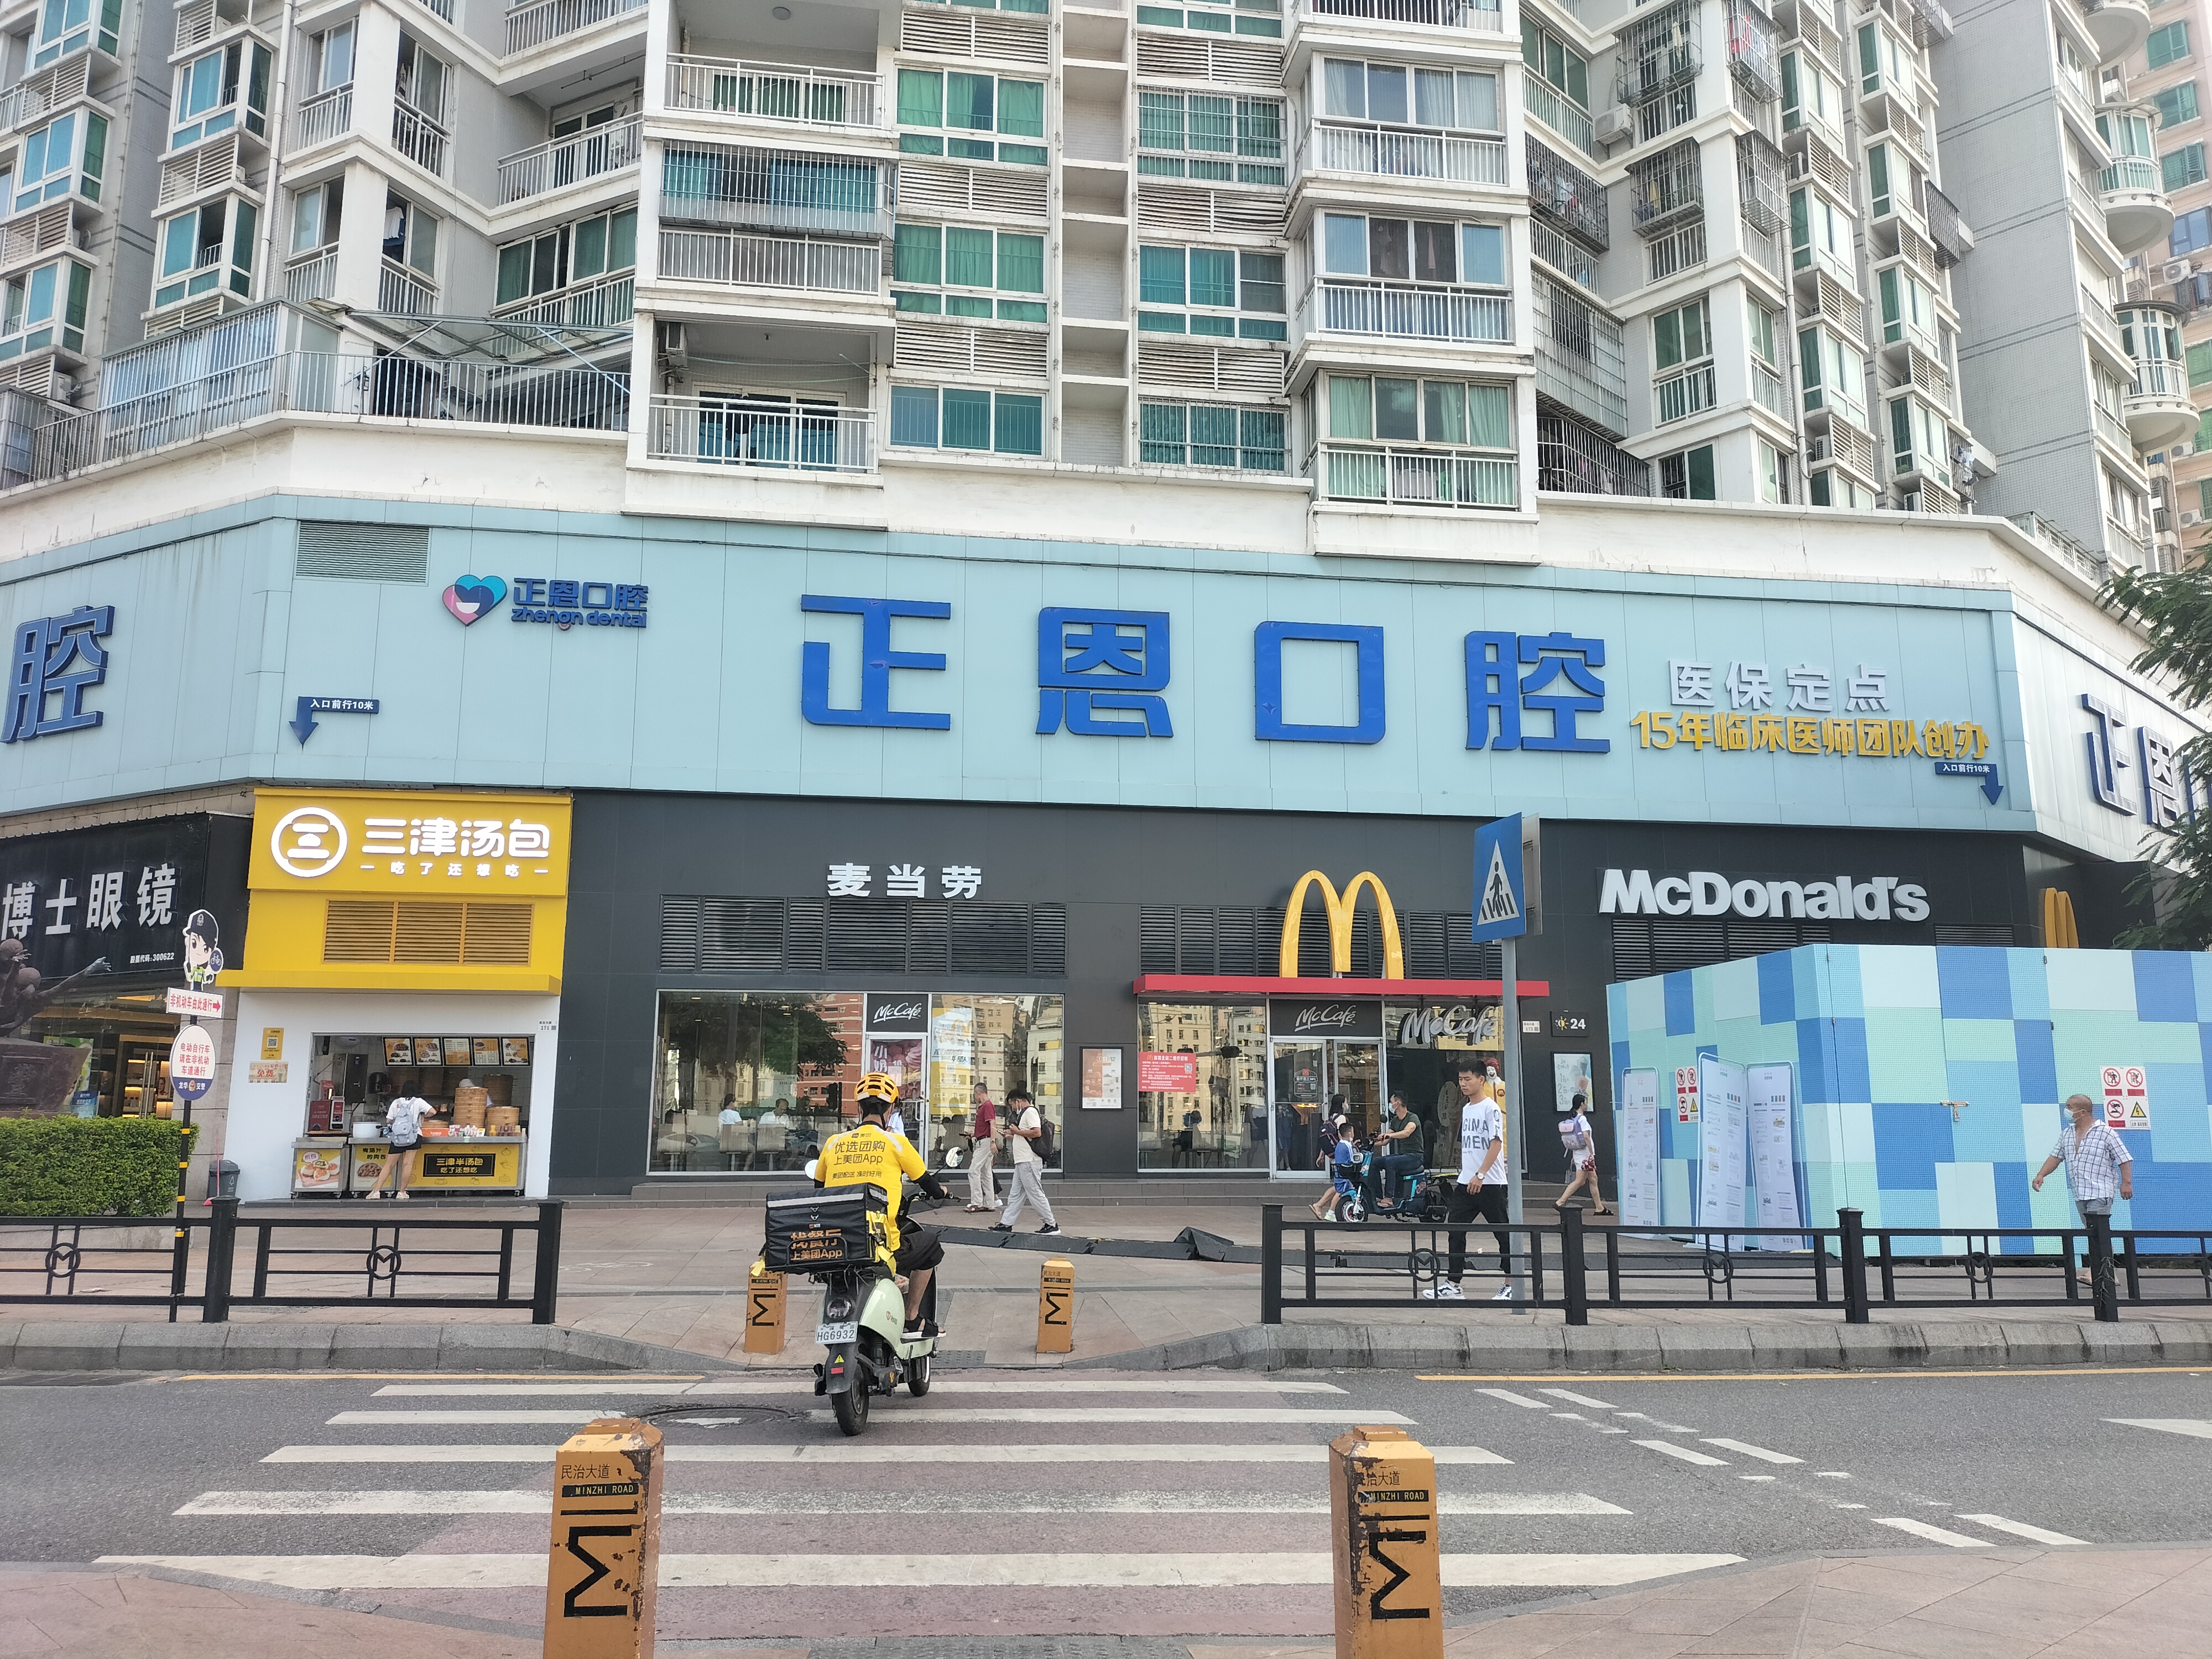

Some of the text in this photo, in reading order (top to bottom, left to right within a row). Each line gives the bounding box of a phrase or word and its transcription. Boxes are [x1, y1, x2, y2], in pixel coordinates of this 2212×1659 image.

[513, 577, 649, 612] 正恩口腔
[586, 611, 646, 628] dental
[0, 605, 115, 744] 腔
[801, 594, 1610, 754] 正恩口腔
[1669, 660, 1890, 712] 医保定点
[310, 699, 374, 710] 入口前行10米
[1630, 711, 1991, 759] 15年临床医师团队创办
[1943, 763, 1990, 773] 入口前行10米
[2081, 693, 2212, 836] 正恩
[362, 817, 550, 858] 三津汤包
[827, 863, 982, 899] 麦当劳
[1, 863, 176, 940] 博士眼镜
[1599, 869, 1931, 922] McDonald's
[170, 994, 213, 1012] 非机动车由此通行
[873, 1003, 922, 1023] McCafé
[1295, 1004, 1357, 1031] McCafé
[1570, 1018, 1587, 1030] 24
[180, 1042, 210, 1053] 电动自行车
[179, 1054, 210, 1065] 请在非机动
[181, 1066, 206, 1076] 车道通行
[835, 1140, 885, 1154] 优选团购
[436, 1157, 483, 1166] 三津半汤包
[834, 1154, 883, 1165] 上美团App
[790, 1248, 843, 1261] 上美团App
[817, 1329, 854, 1341] HG6932
[561, 1463, 610, 1480] 民治大道
[575, 1485, 634, 1495] MINZHI ROAD
[1404, 1490, 1425, 1501] ROAD
